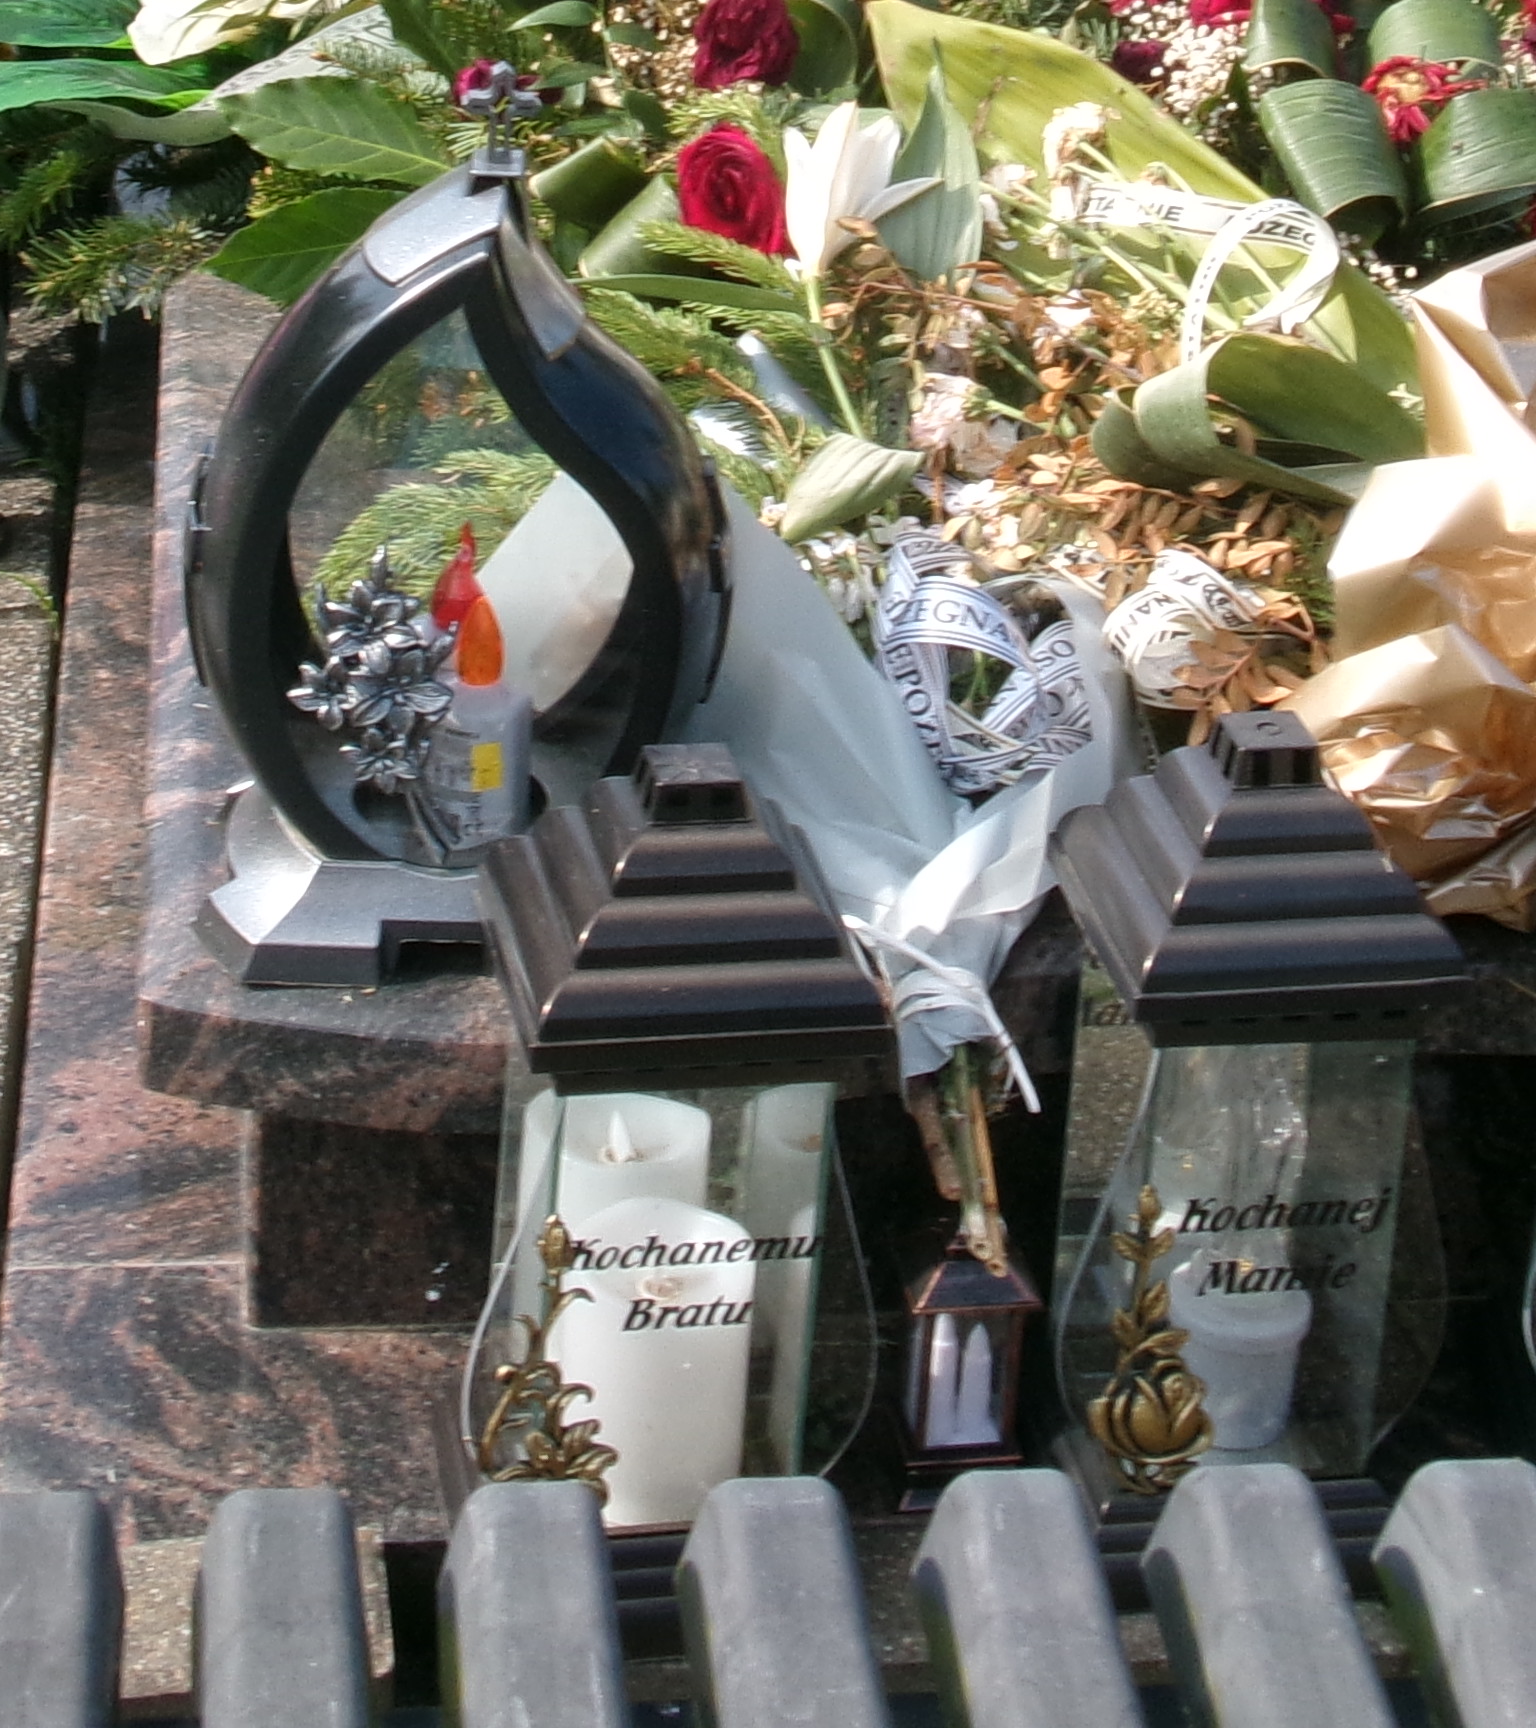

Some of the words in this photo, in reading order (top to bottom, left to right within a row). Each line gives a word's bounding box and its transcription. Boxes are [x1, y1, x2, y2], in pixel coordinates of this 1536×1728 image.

[1177, 1186, 1393, 1234] Kochanej
[567, 1234, 821, 1271] Kochanemu
[622, 1294, 755, 1332] Bratu
